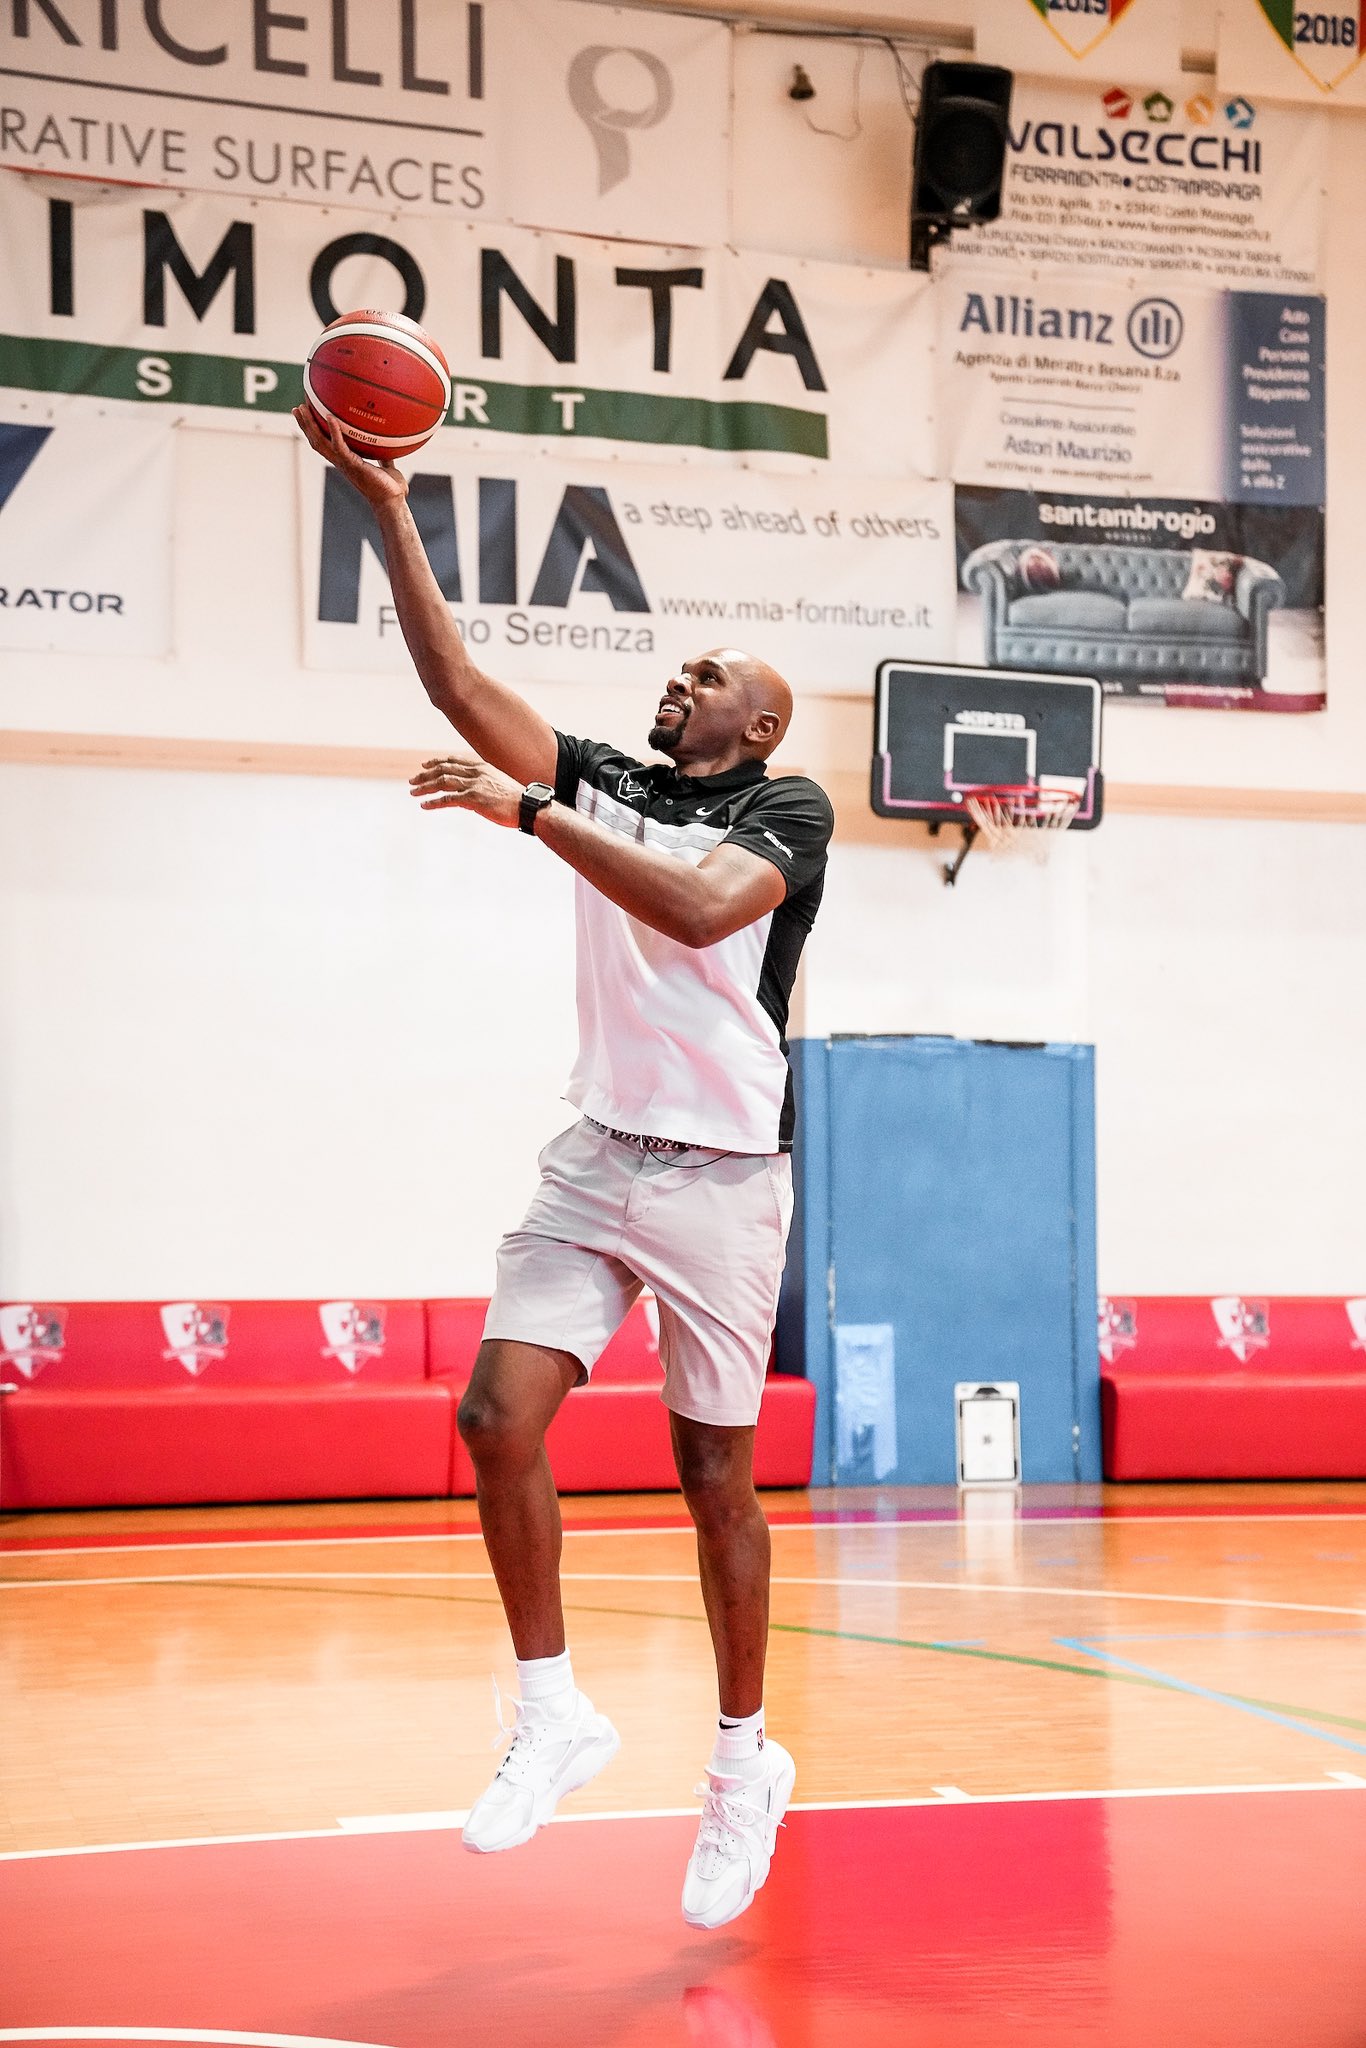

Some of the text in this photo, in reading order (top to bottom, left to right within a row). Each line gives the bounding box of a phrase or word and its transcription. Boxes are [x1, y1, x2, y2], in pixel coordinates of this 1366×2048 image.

[1296, 13, 1356, 46] 2018
[0, 107, 485, 209] RATIVE SURFACES
[48, 198, 827, 392] IMONTA
[960, 293, 1114, 346] Allianz
[136, 356, 586, 431] SPRT
[624, 501, 940, 540] a step ahead of others
[1038, 504, 1216, 539] santambrogio
[318, 466, 652, 624] MIA
[506, 612, 655, 652] Serenza
[660, 596, 932, 629] www.mia-forniture.it
